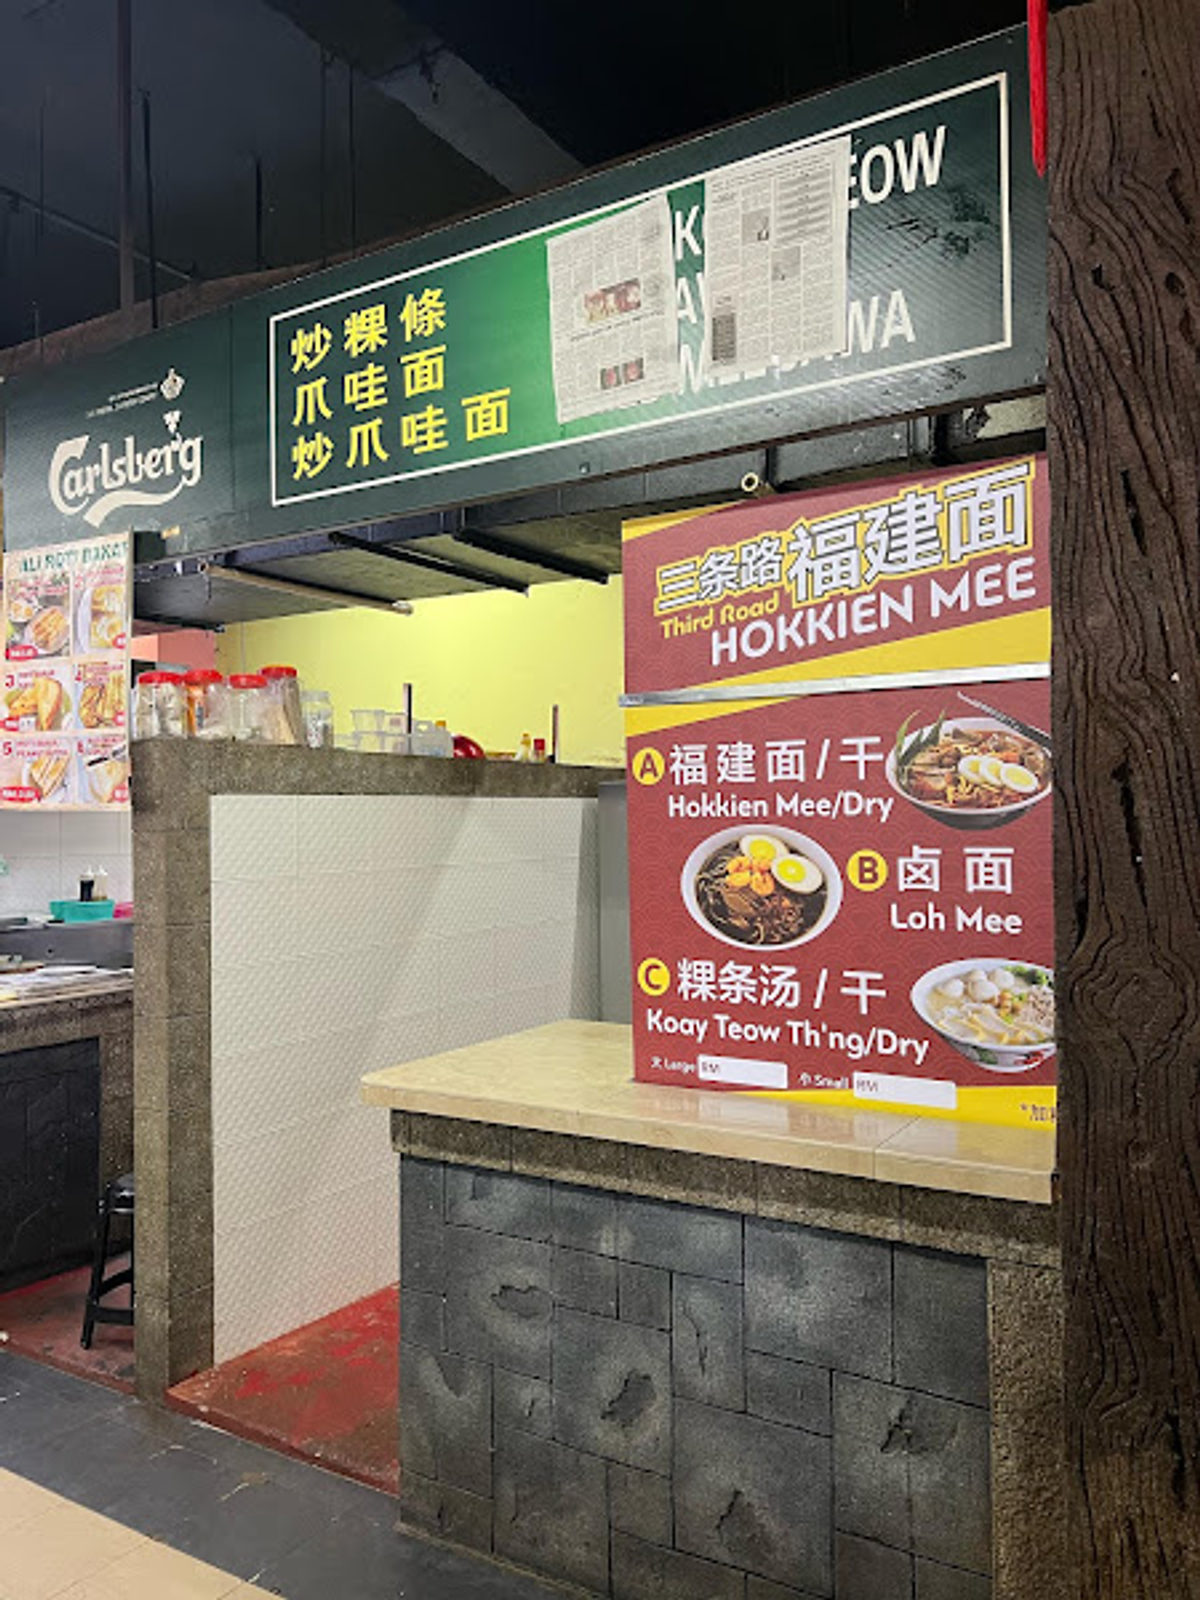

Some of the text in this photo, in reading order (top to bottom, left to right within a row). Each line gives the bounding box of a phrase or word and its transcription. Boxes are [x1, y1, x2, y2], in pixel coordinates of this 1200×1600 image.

[290, 287, 447, 375] 炒粿條
[291, 343, 448, 427] 爪哇面
[290, 386, 512, 482] 炒爪哇面
[48, 432, 204, 520] Carlsberg
[659, 592, 781, 640] Third Road
[710, 556, 1038, 667] HOKKIEN MEE
[639, 751, 660, 779] A
[667, 790, 895, 823] Hokkien Mee/Dry
[857, 856, 879, 885] B
[896, 845, 1015, 896] 卤面
[890, 901, 1024, 935] Loh Mee
[644, 964, 663, 989] C
[646, 1008, 930, 1066] Koay Teow Th'ng/Dry
